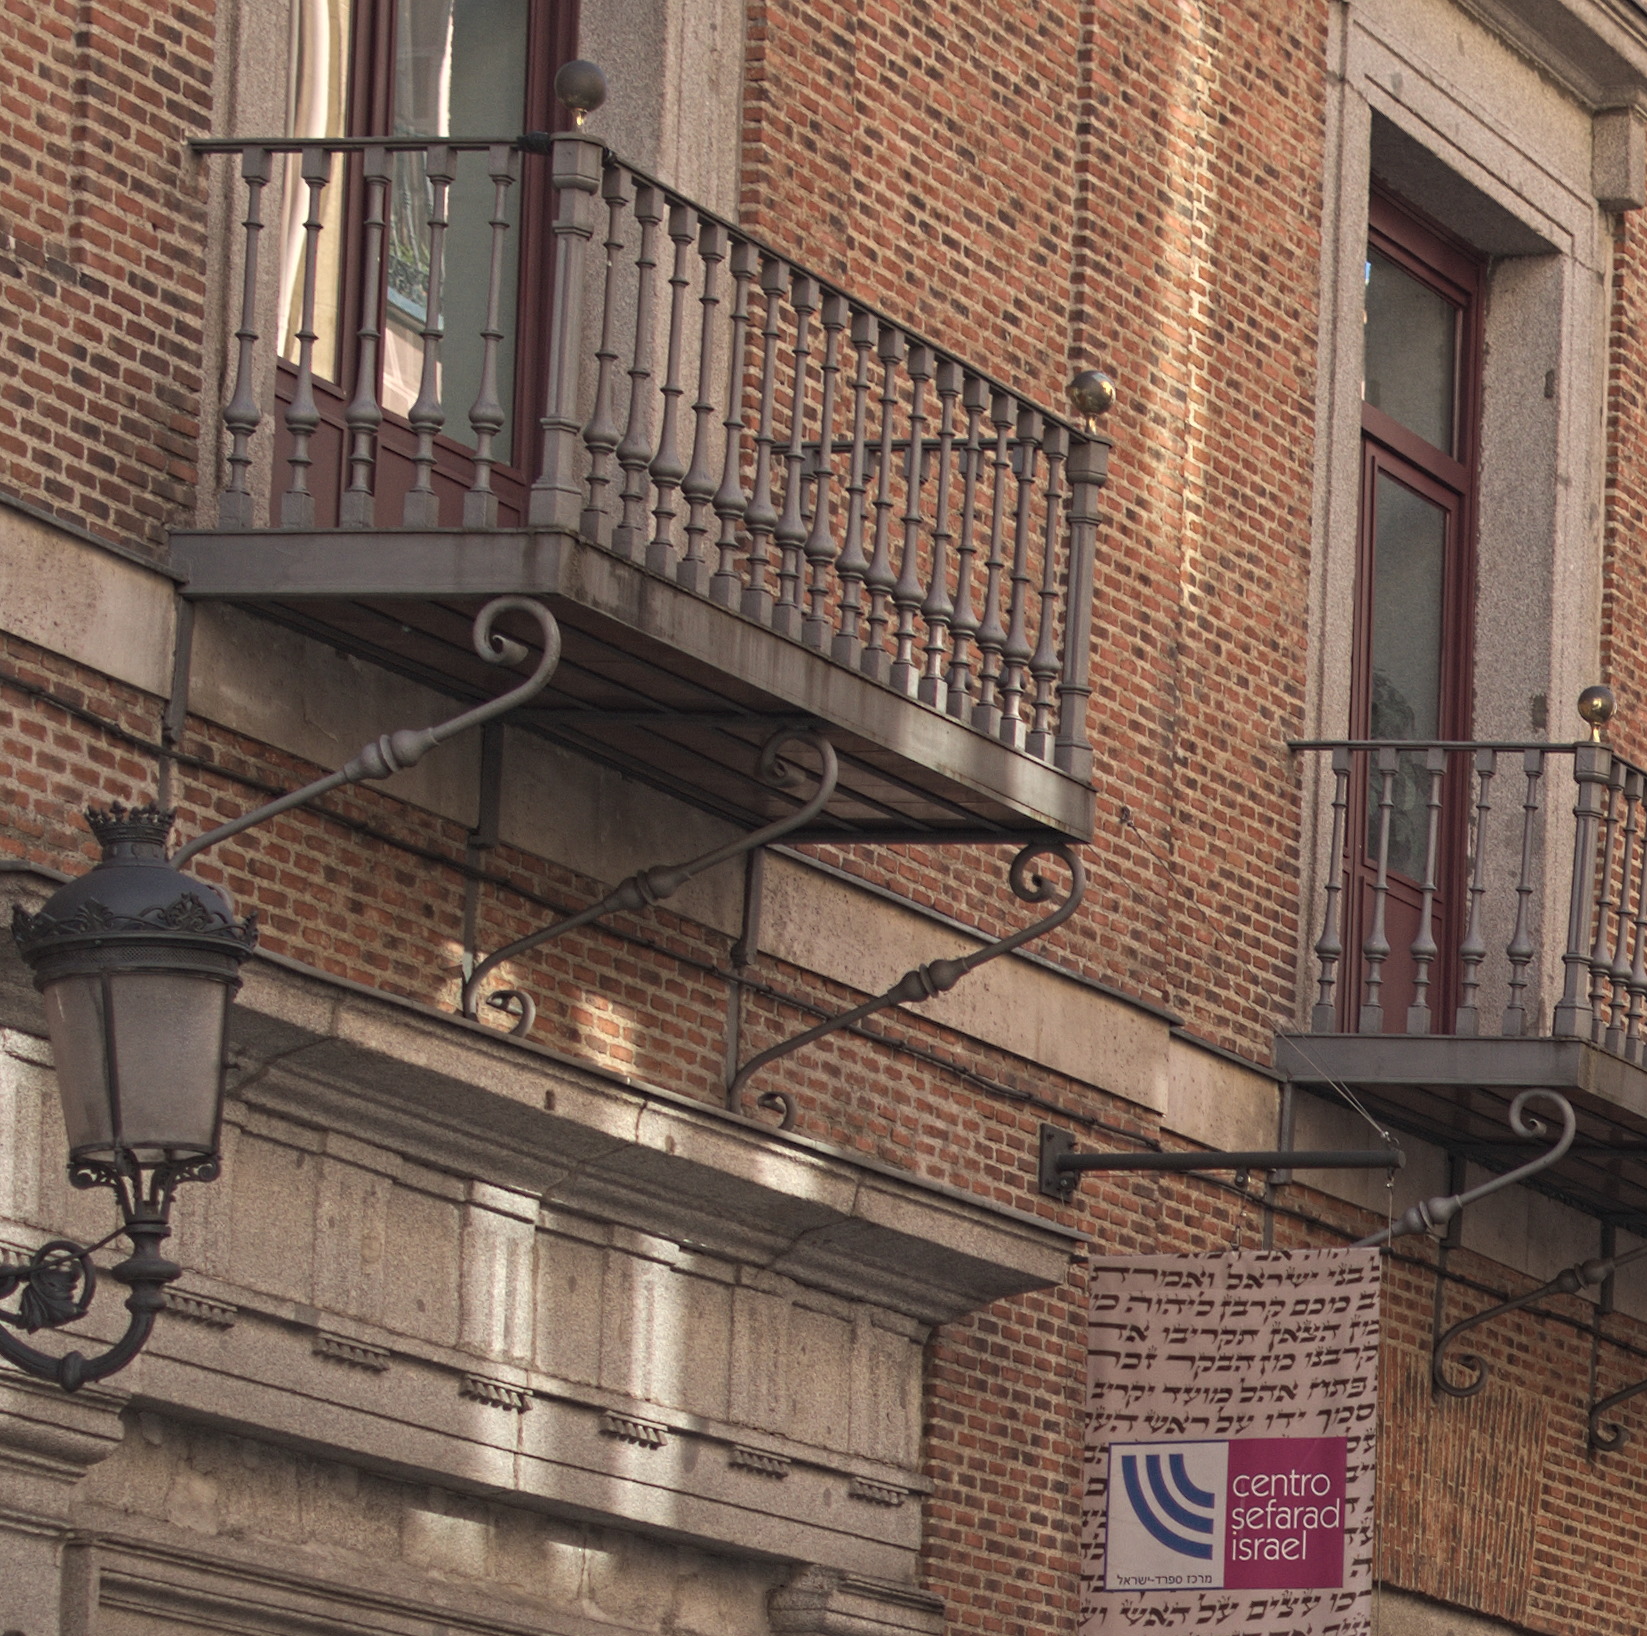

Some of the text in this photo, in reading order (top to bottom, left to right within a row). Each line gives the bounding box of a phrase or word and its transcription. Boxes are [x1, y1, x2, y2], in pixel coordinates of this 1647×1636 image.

[1232, 1469, 1330, 1497] centro
[1231, 1498, 1340, 1530] sefarad
[1232, 1530, 1307, 1560] israel
[1187, 1575, 1213, 1584] מרכז
